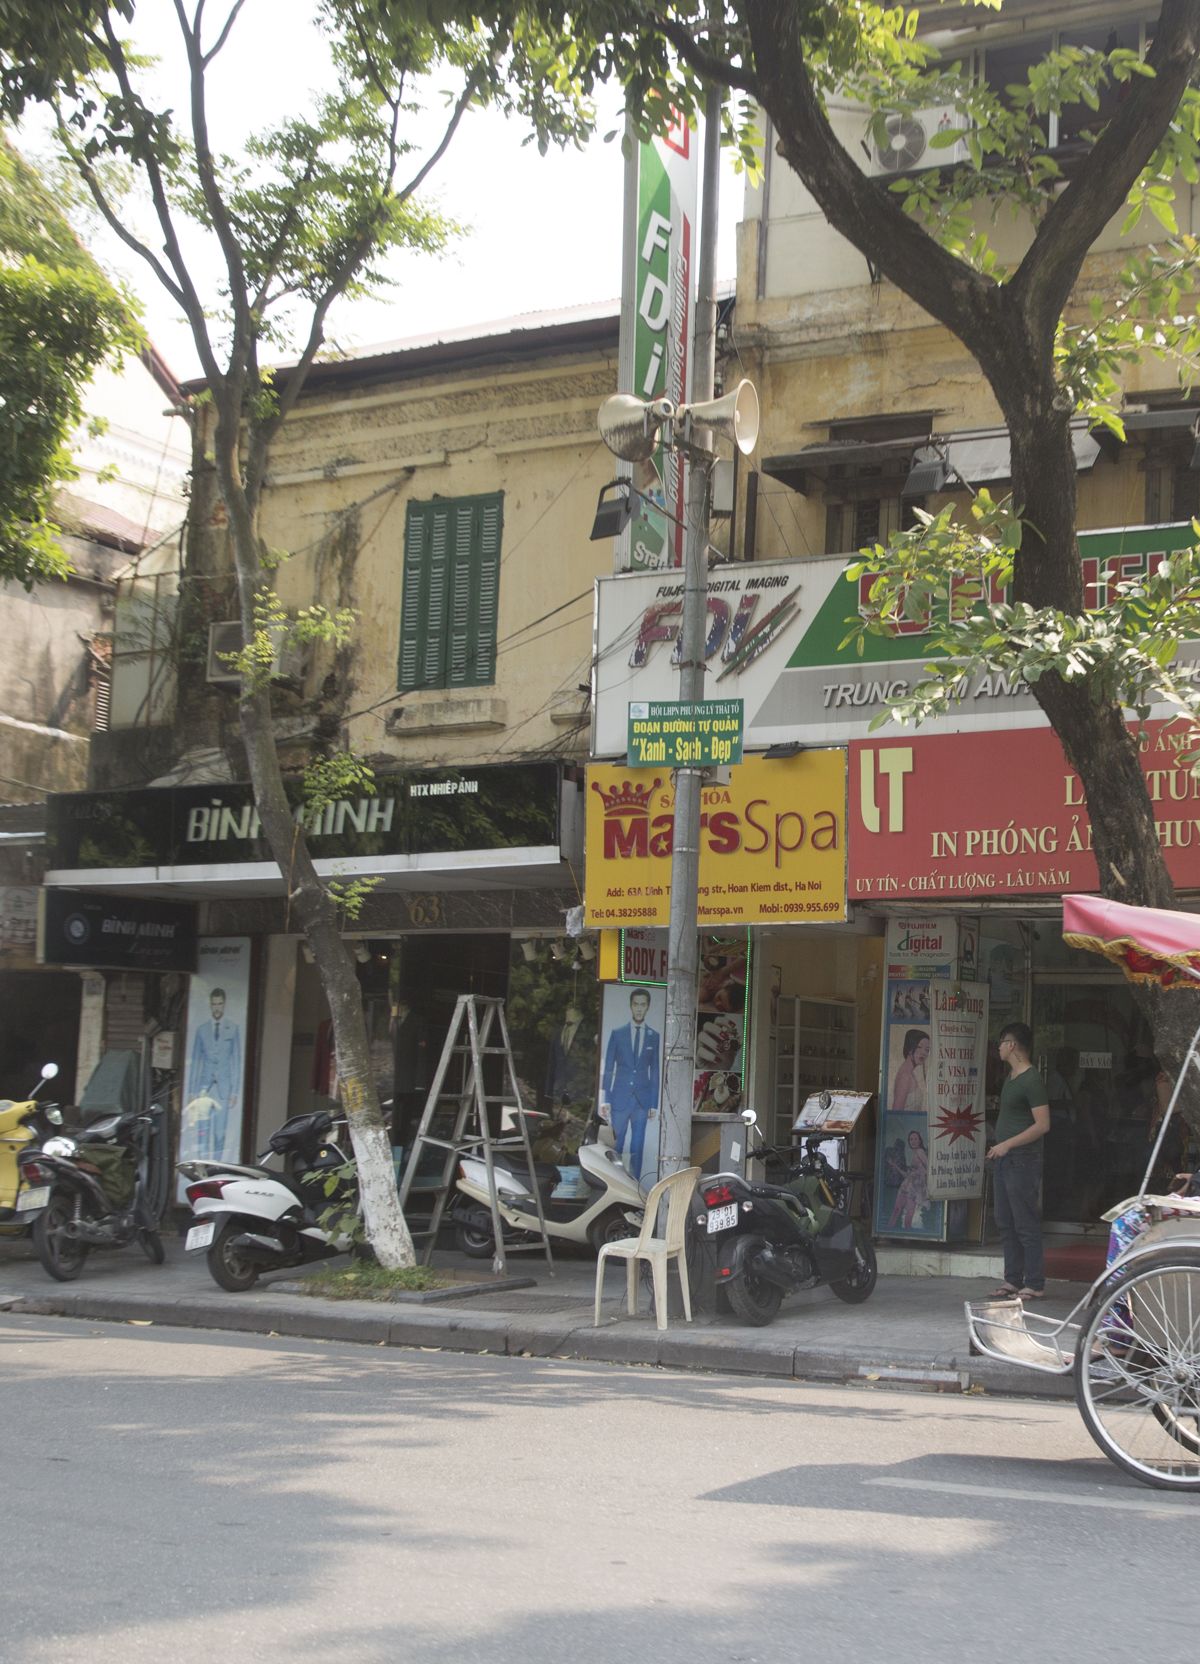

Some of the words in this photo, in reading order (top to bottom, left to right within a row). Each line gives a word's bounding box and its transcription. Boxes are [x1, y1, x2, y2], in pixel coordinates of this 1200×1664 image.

[746, 575, 789, 588] IMAGING
[633, 722, 661, 736] ĐOẠN
[712, 715, 739, 733] QUẢN
[410, 784, 428, 797] HTX
[930, 829, 959, 858] IN
[964, 821, 1058, 858] PHÓNG
[878, 873, 899, 892] TÍN
[908, 868, 946, 891] CHẤT
[1007, 867, 1036, 888] LÂU
[1037, 867, 1071, 886] NĂM
[896, 930, 943, 953] digital
